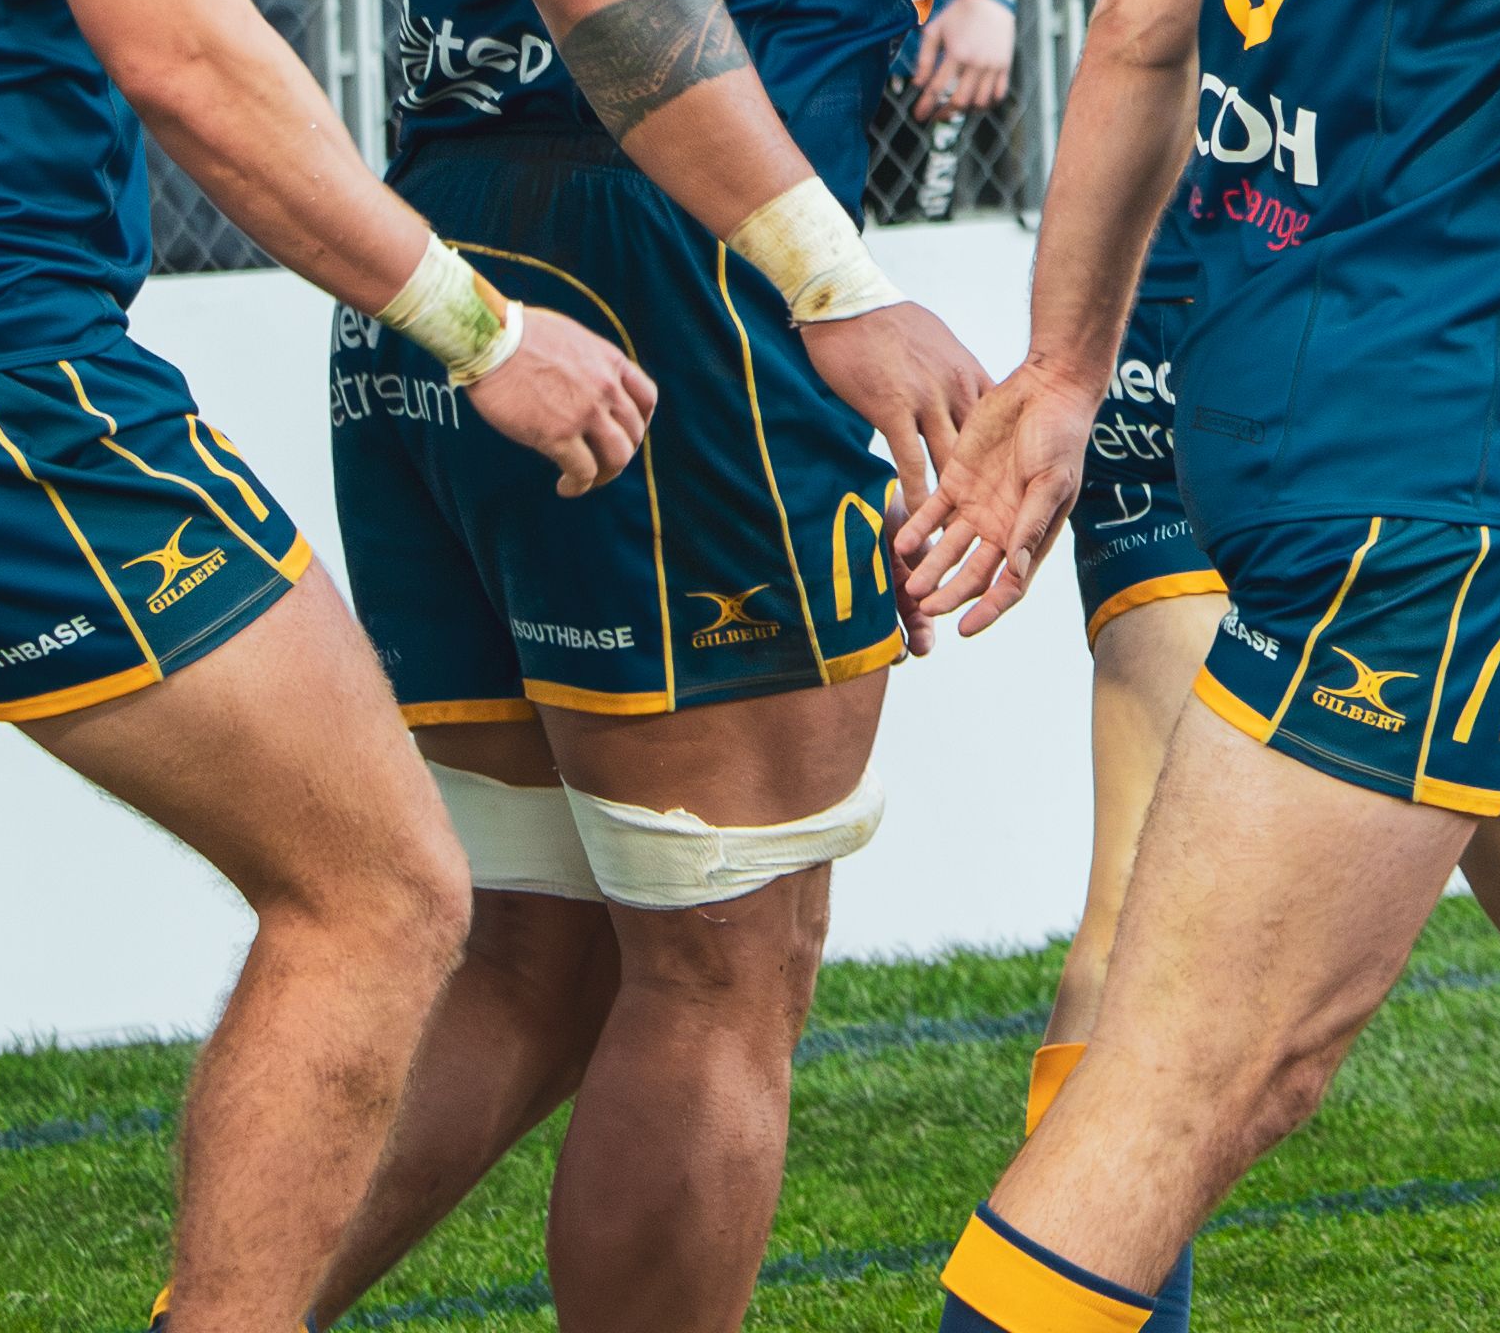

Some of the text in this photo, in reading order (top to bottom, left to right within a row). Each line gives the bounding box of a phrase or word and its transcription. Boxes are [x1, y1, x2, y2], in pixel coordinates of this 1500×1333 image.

[148, 549, 228, 614] GILBERT
[515, 620, 636, 650] SOUTHBASE
[692, 623, 781, 649] GILBERT
[1312, 689, 1407, 733] GILBERT
